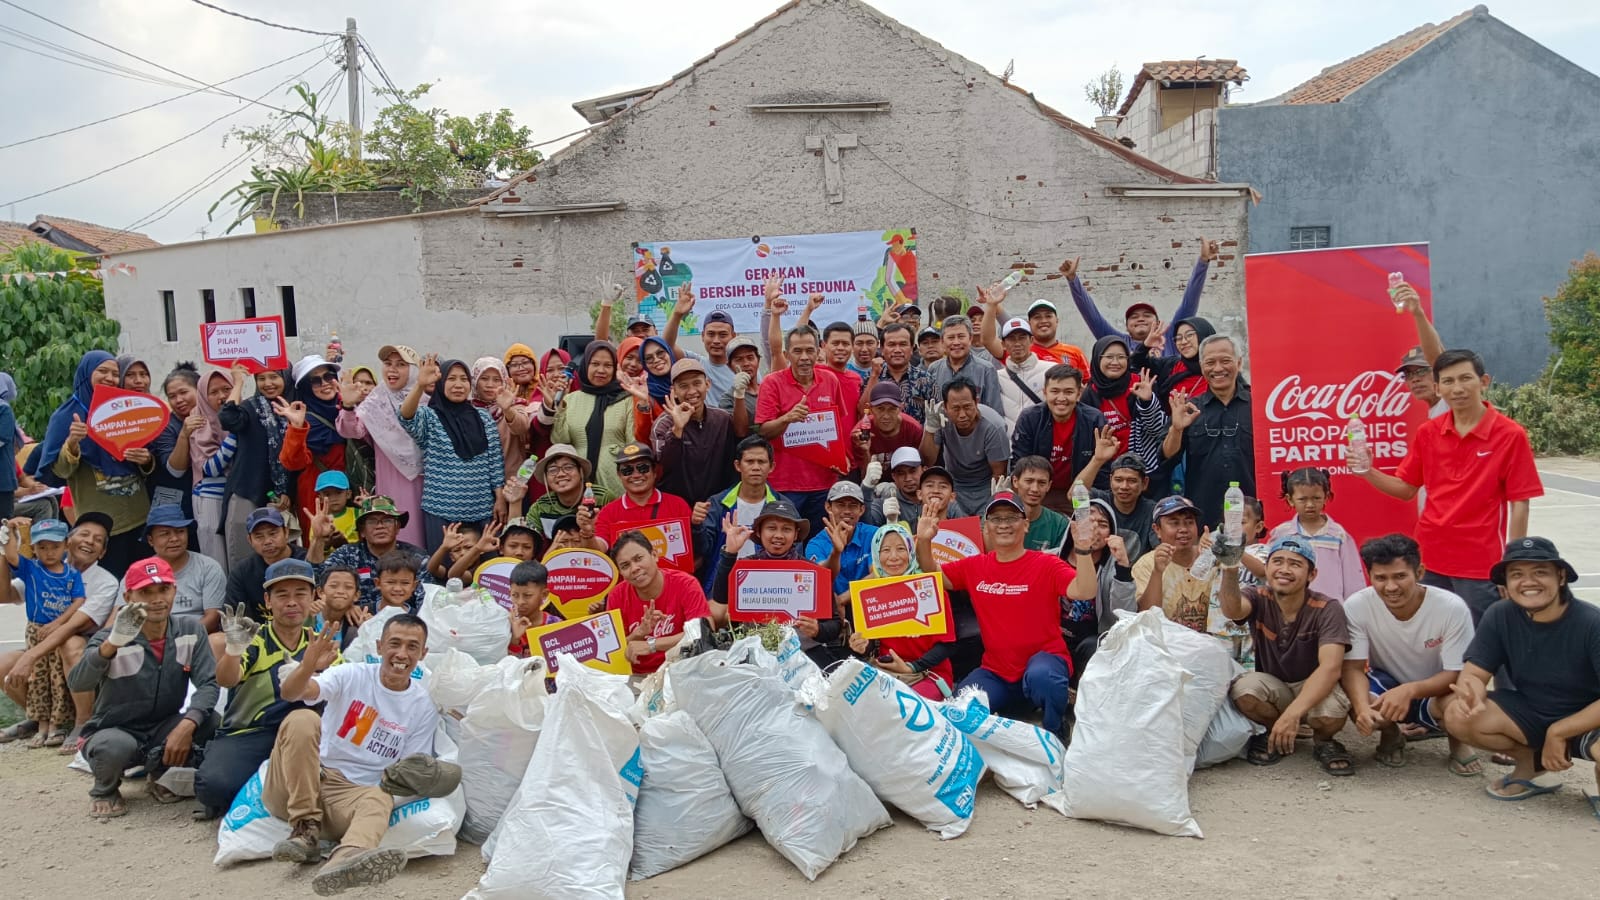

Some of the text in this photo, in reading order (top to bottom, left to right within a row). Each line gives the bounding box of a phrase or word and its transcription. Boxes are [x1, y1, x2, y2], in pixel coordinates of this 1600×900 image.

[801, 280, 856, 294] SEDUNIA
[218, 347, 248, 355] SAMPAH
[1265, 370, 1412, 423] Coca-Cola
[94, 419, 127, 433] SAMPAH
[867, 596, 917, 613] PILAH SAMPAH
[869, 606, 915, 621] DARI SUMBERNYA
[544, 637, 560, 649] BCL
[573, 636, 593, 649] CINTA
[843, 676, 864, 702] GULA
[372, 726, 402, 747] GET IN
[366, 740, 400, 759] ACTION
[402, 800, 430, 819] GULA
